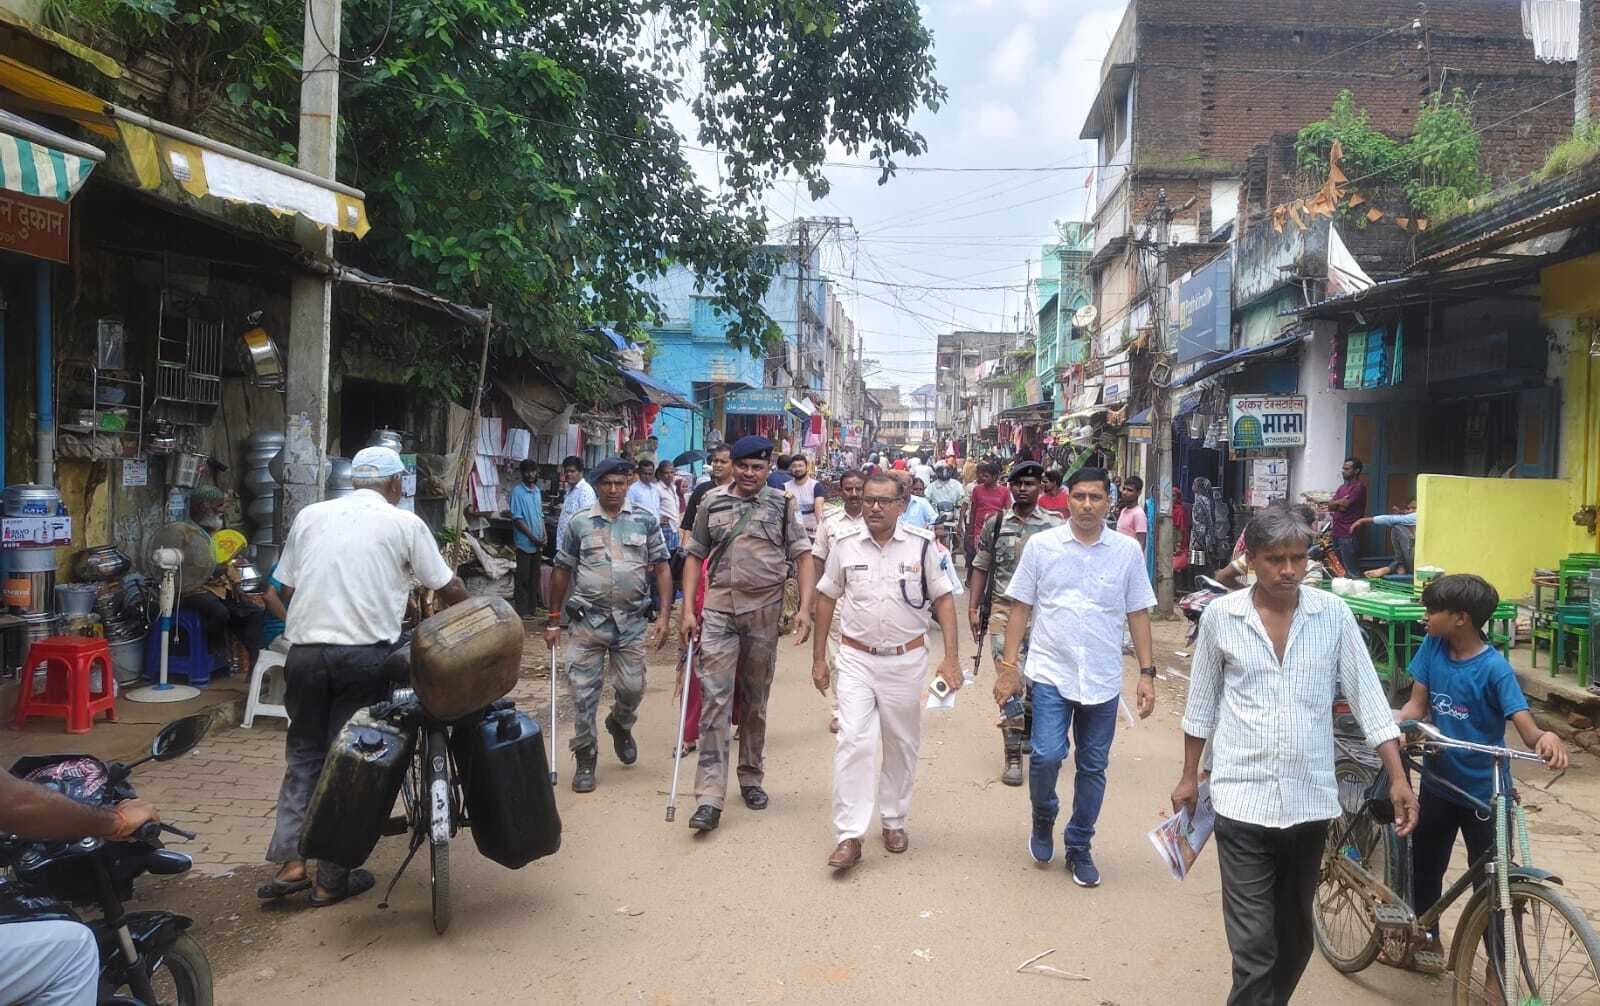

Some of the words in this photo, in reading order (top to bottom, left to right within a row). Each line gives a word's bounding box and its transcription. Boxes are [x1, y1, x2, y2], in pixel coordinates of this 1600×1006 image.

[17, 202, 64, 240] दुकान
[1235, 398, 1262, 412] शंकर
[1262, 414, 1303, 433] मामा
